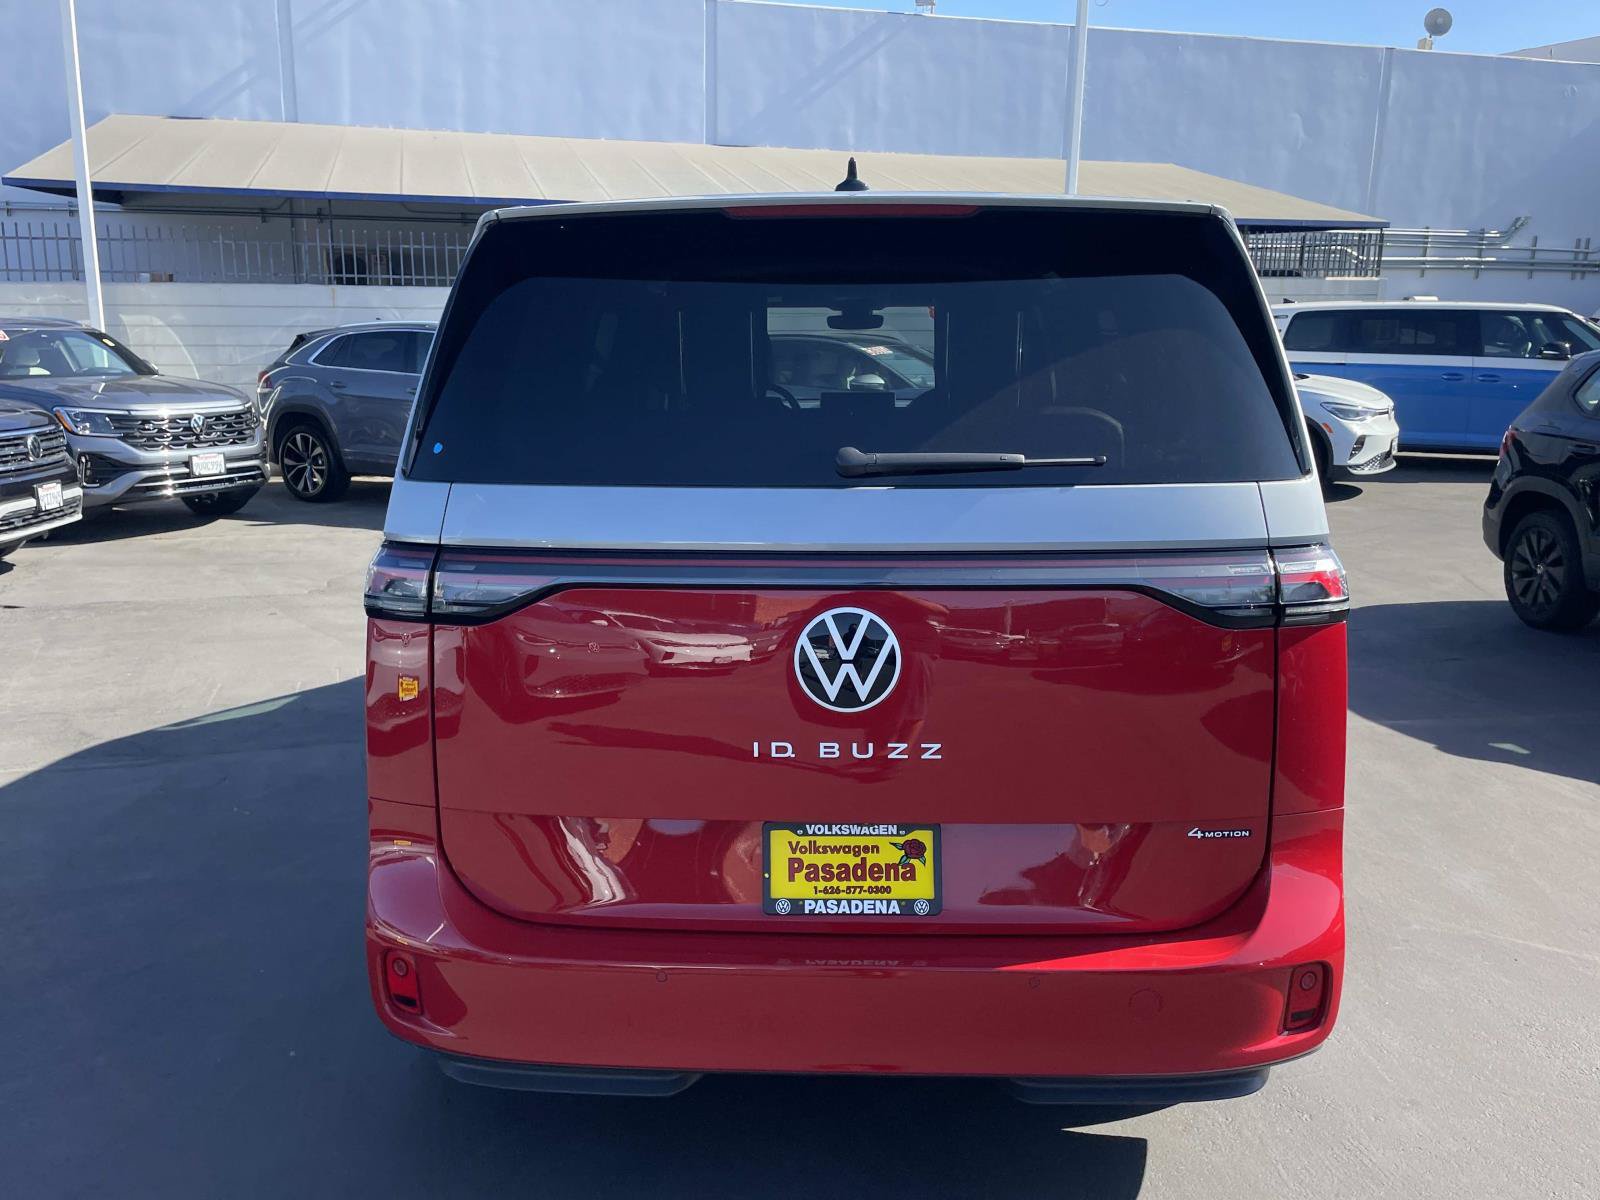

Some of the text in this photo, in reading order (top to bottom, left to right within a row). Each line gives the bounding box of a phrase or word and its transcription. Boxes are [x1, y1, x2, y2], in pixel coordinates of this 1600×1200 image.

[819, 742, 942, 759] BUZZ
[805, 824, 897, 835] VOLKSWAGEN
[1187, 827, 1249, 839] 4MOTION
[787, 840, 880, 857] Volkswagen
[787, 857, 916, 882] Pasadena
[813, 885, 892, 895] 1-626-577-0300
[804, 899, 901, 914] PASADENA
